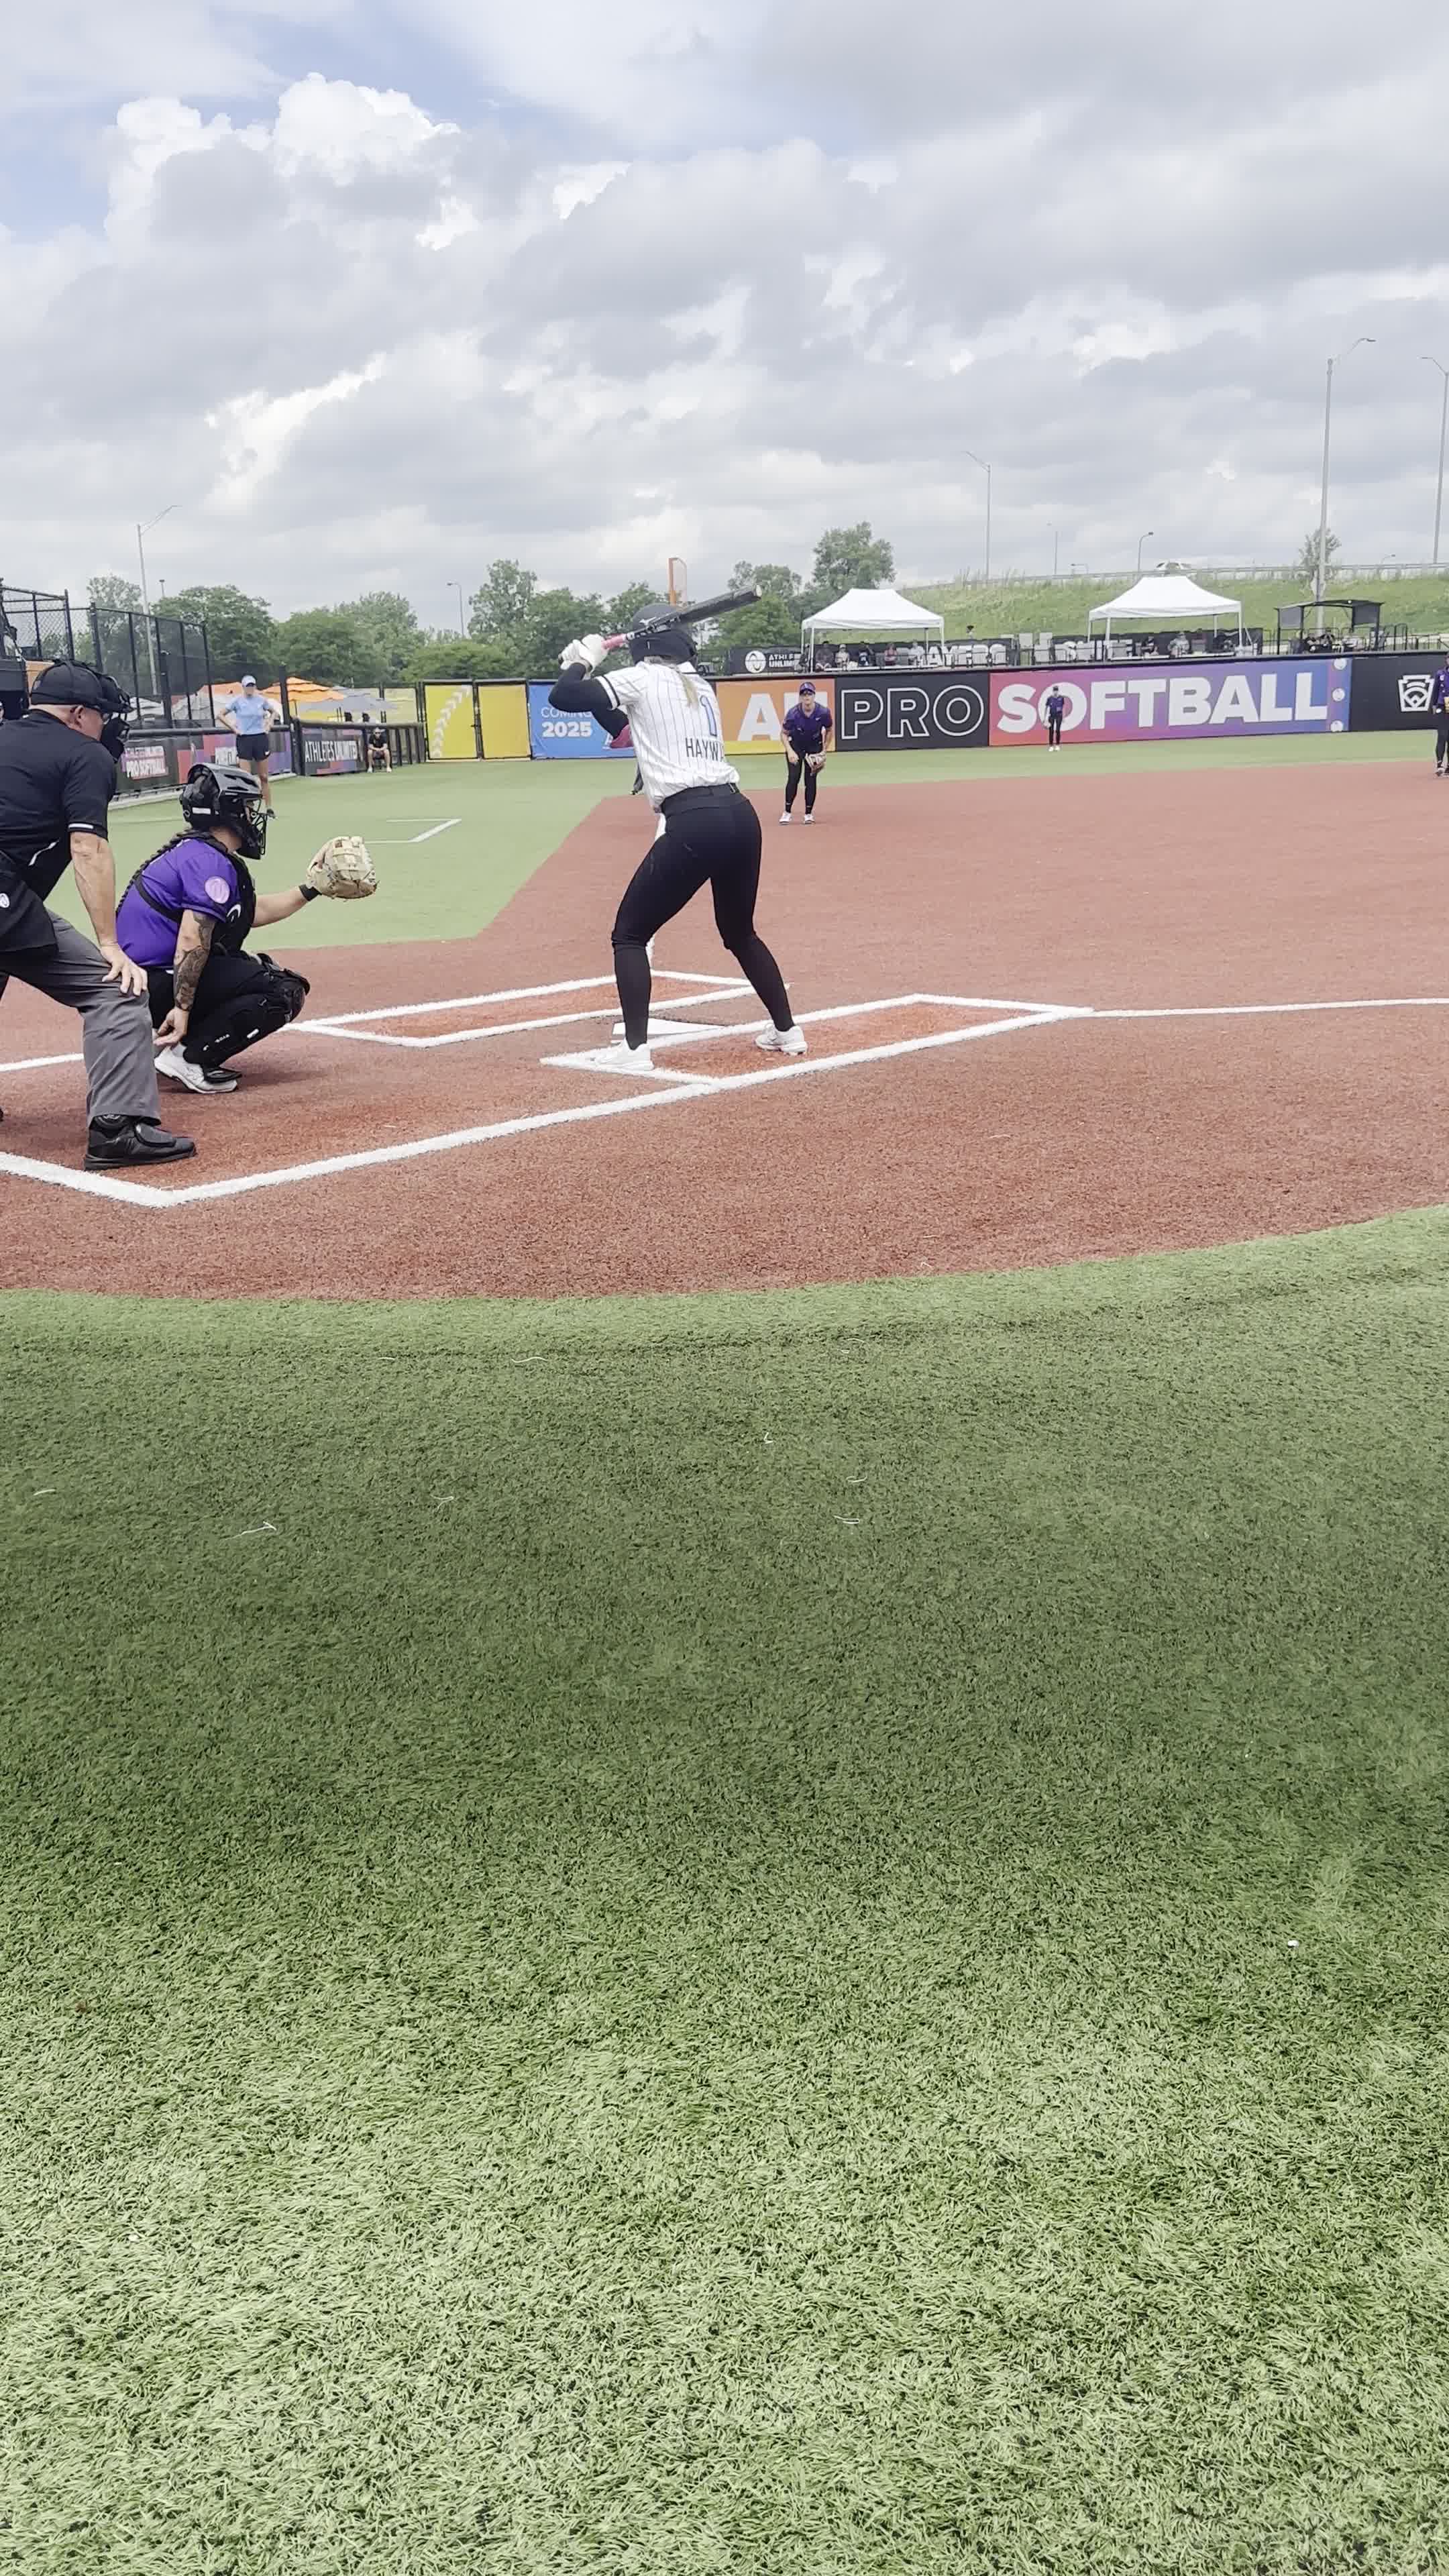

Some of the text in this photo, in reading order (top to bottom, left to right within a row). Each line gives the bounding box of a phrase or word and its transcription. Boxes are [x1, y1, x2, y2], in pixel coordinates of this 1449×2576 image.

[768, 660, 795, 668] UNLIM
[841, 684, 984, 740] PRO
[997, 672, 1328, 733] SOFTBALL
[541, 721, 592, 738] 2025
